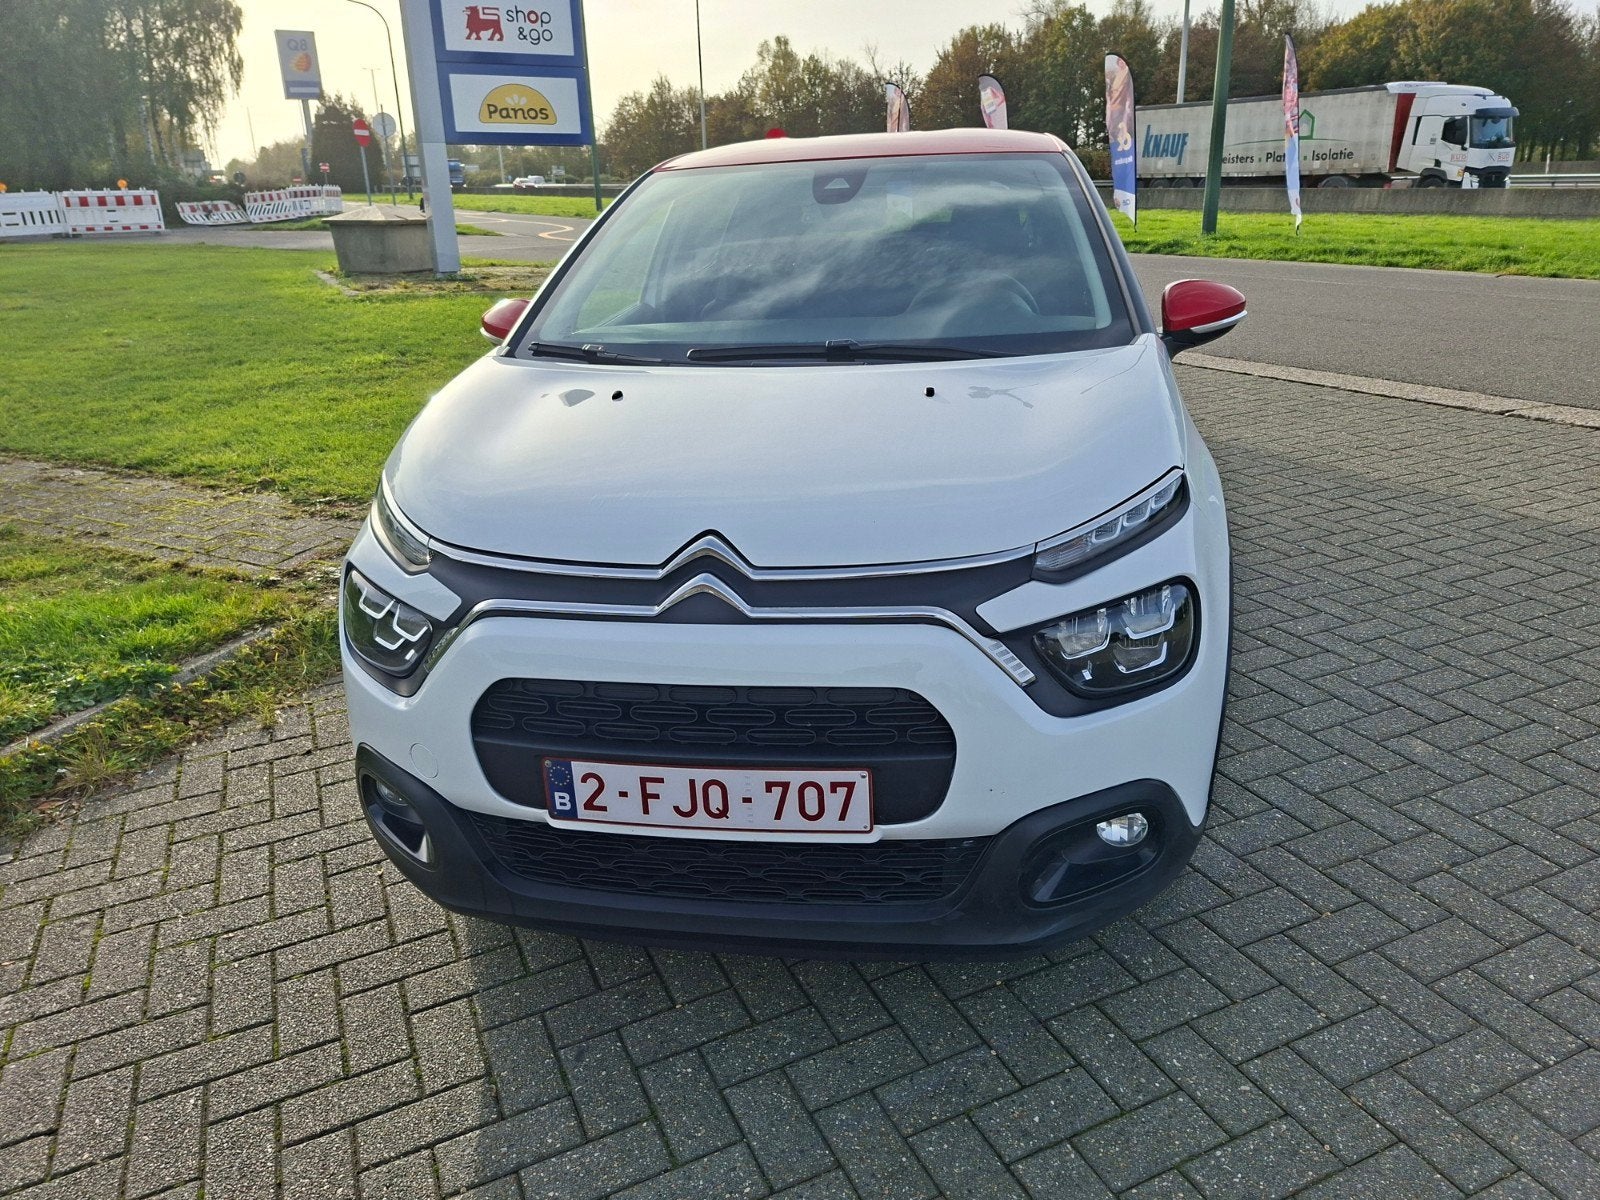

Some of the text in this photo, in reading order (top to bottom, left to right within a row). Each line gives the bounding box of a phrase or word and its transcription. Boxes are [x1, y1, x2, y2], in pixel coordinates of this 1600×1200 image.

[506, 5, 552, 27] shop
[287, 38, 307, 51] Q8
[517, 27, 553, 45] &go
[487, 103, 549, 120] Panos
[1312, 148, 1354, 161] Isolatie
[554, 791, 571, 811] B
[580, 771, 857, 822] 2-FJQ-707
